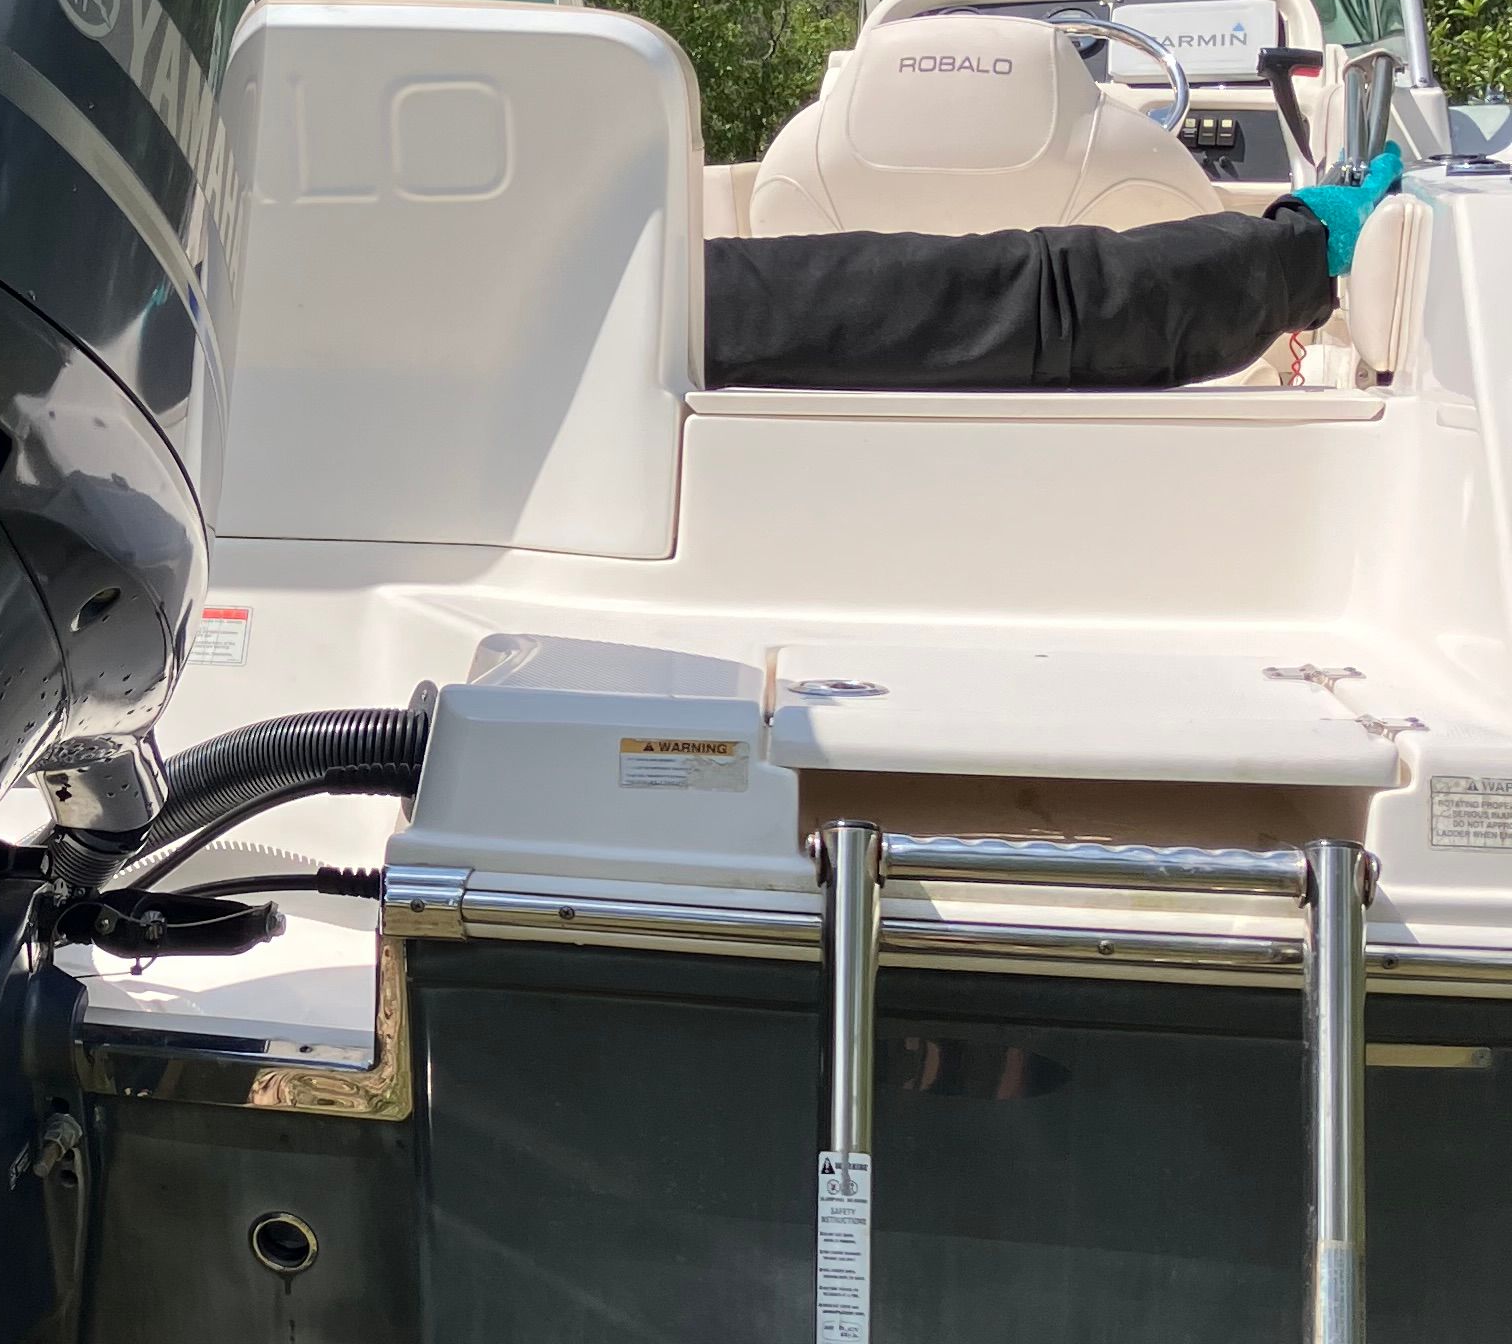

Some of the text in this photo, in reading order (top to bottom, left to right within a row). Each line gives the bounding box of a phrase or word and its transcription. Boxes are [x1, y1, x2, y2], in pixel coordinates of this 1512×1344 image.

[1149, 33, 1248, 48] ARMIN
[899, 56, 1013, 75] ROBALO
[659, 741, 728, 755] WARNING
